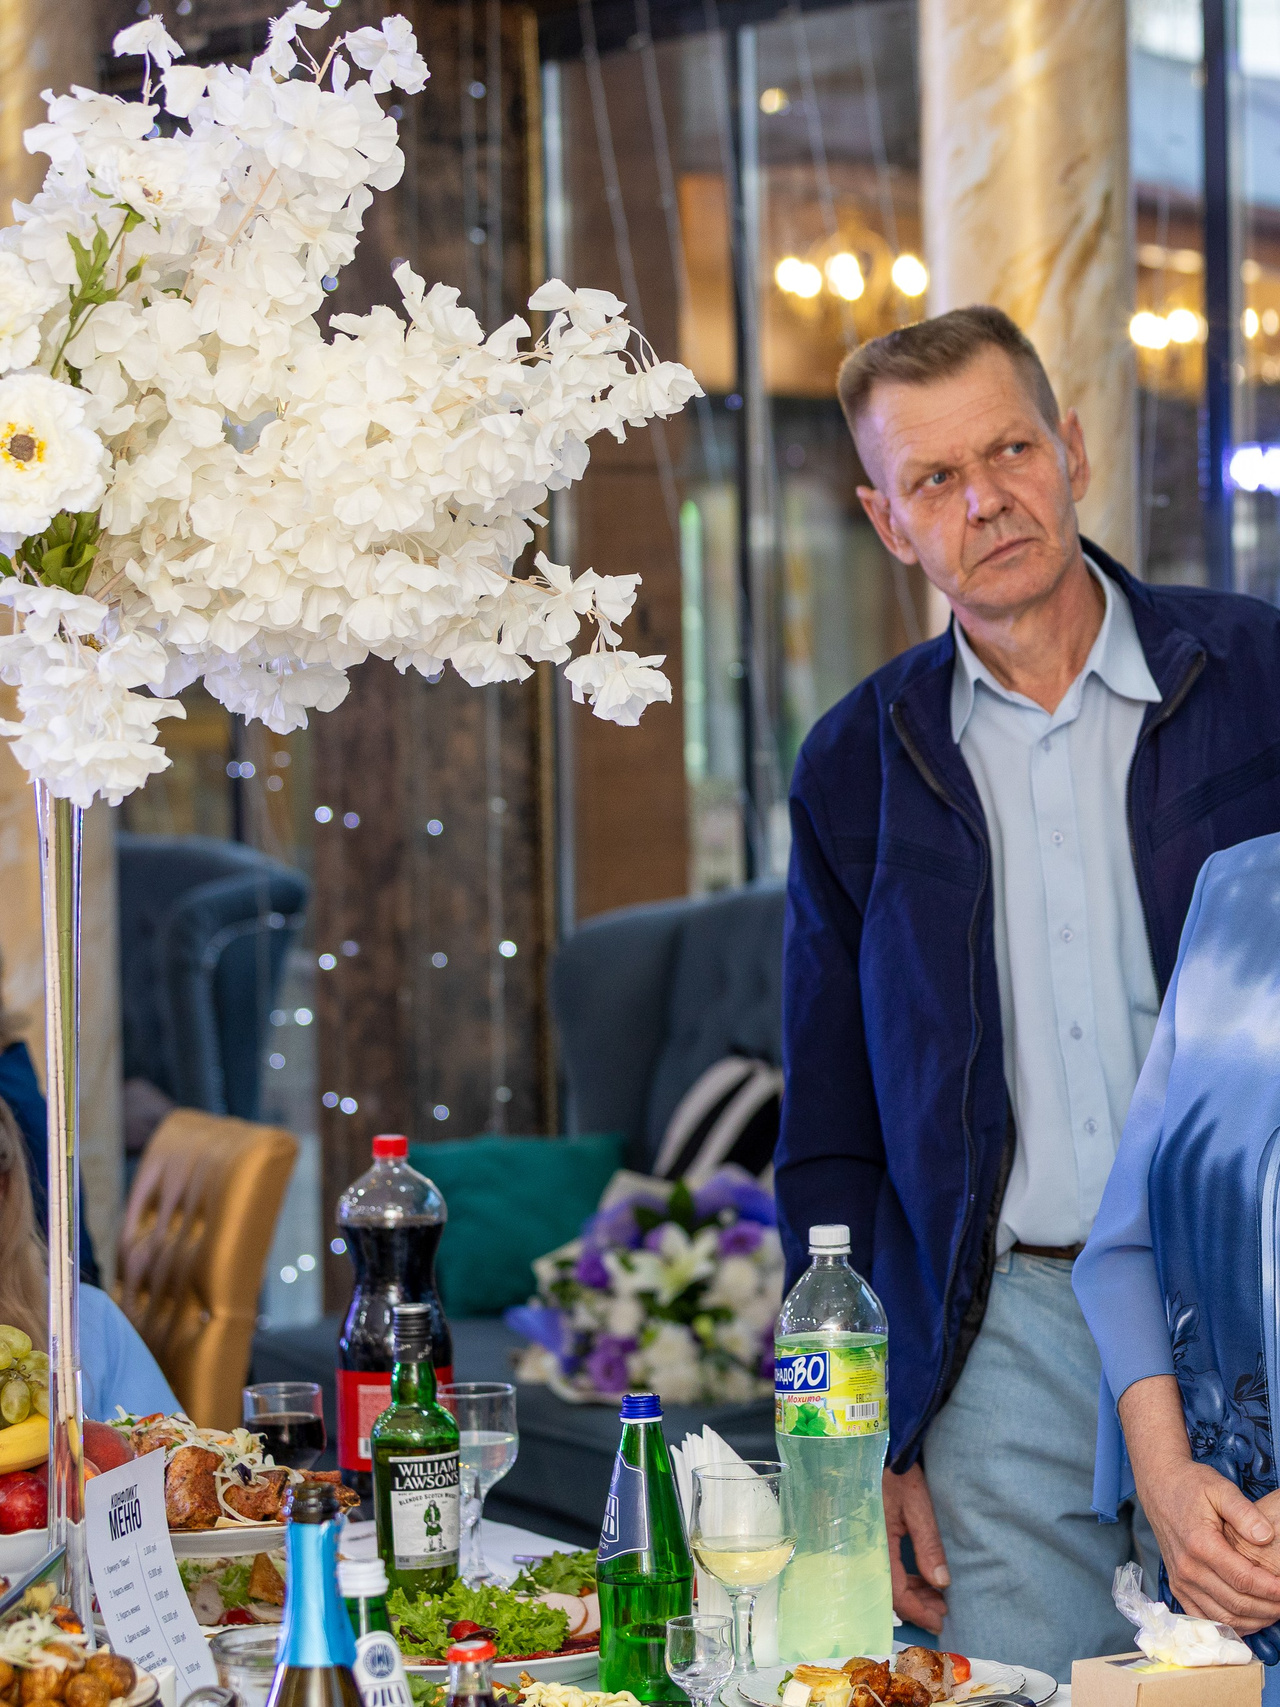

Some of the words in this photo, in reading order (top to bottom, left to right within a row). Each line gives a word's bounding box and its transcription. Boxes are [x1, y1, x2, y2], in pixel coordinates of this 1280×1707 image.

[787, 1395, 821, 1404] Мохито
[398, 1458, 457, 1477] WILLIAM
[394, 1471, 459, 1490] LAWSON'S
[399, 1495, 423, 1506] BLENDED
[108, 1498, 142, 1541] МЕНЮ
